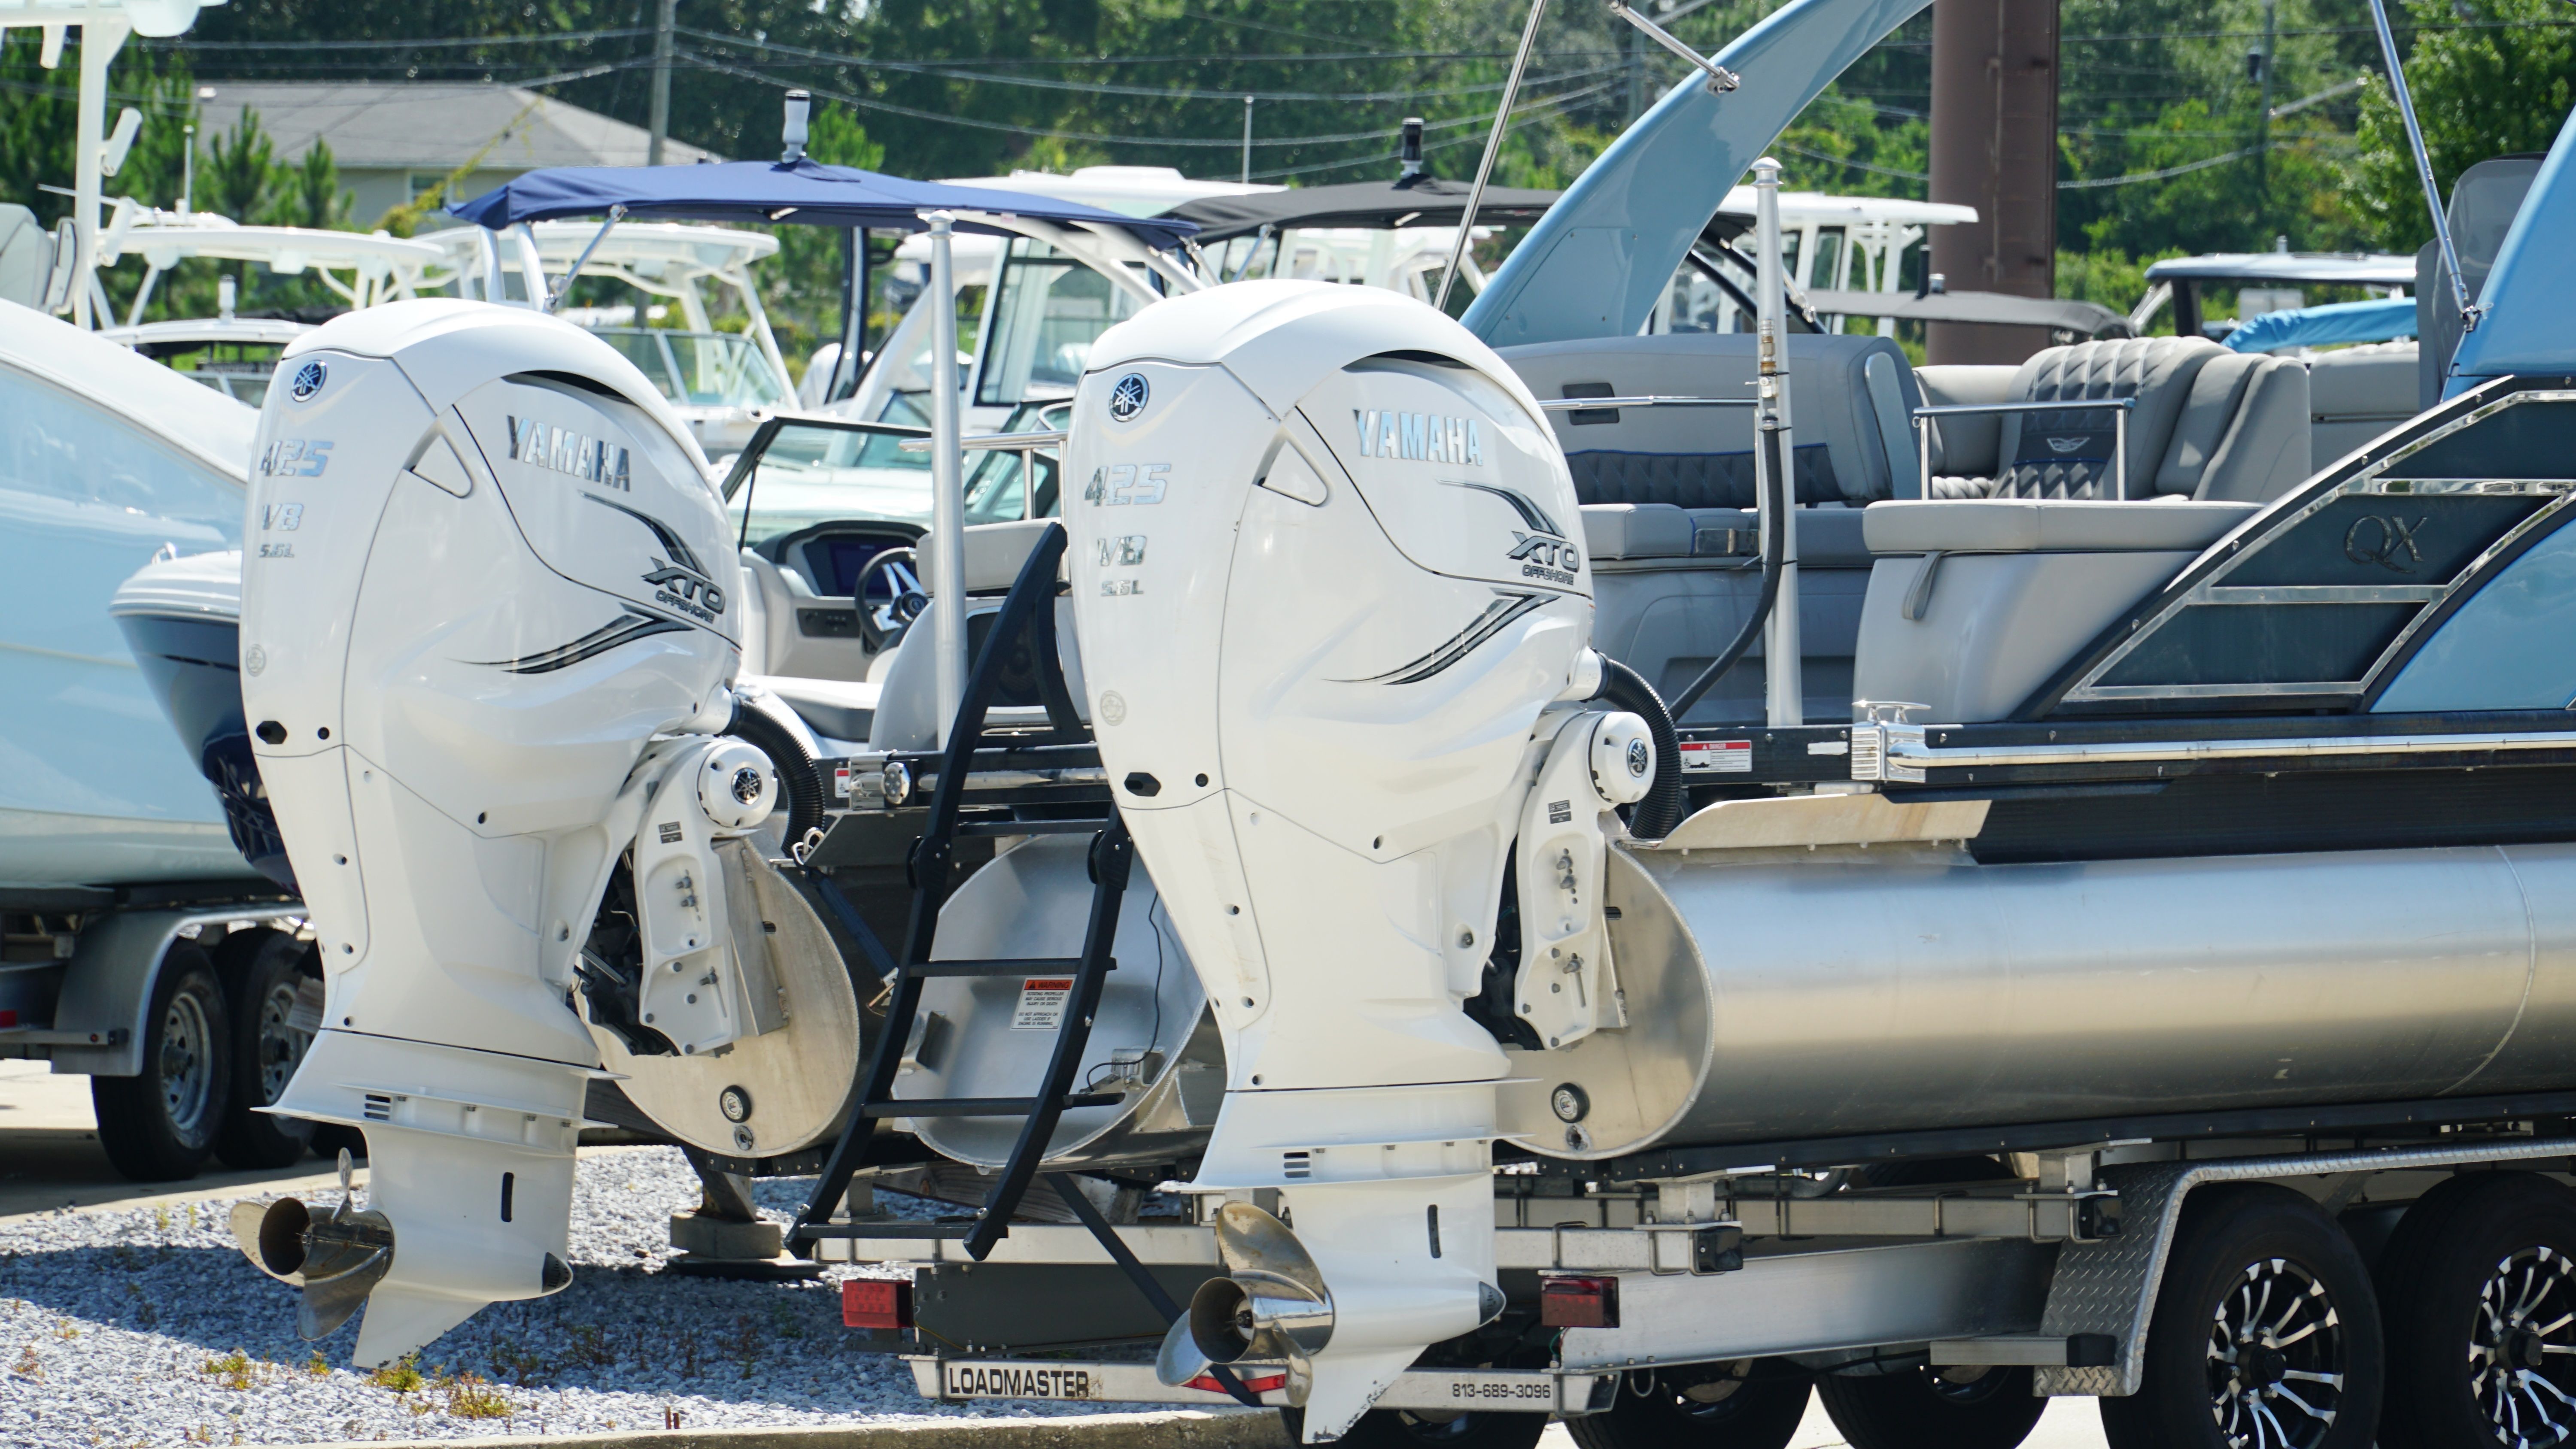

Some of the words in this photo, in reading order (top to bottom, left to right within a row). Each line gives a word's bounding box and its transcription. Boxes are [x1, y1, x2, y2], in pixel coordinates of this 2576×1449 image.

[507, 415, 630, 492] YAMAHA
[1352, 409, 1483, 466] YAMAHA
[259, 439, 334, 477] 425
[1084, 464, 1172, 506] 425
[262, 503, 304, 531] V8
[1097, 535, 1148, 567] V8
[1506, 531, 1580, 573] XTO
[2344, 515, 2427, 574] QX
[641, 556, 726, 615] XTO
[1522, 564, 1574, 585] OFFSHORE
[655, 590, 715, 624] OFFSHORE
[949, 1367, 1089, 1397] LOADMASTER
[1452, 1383, 1550, 1398] 813-689-3096
